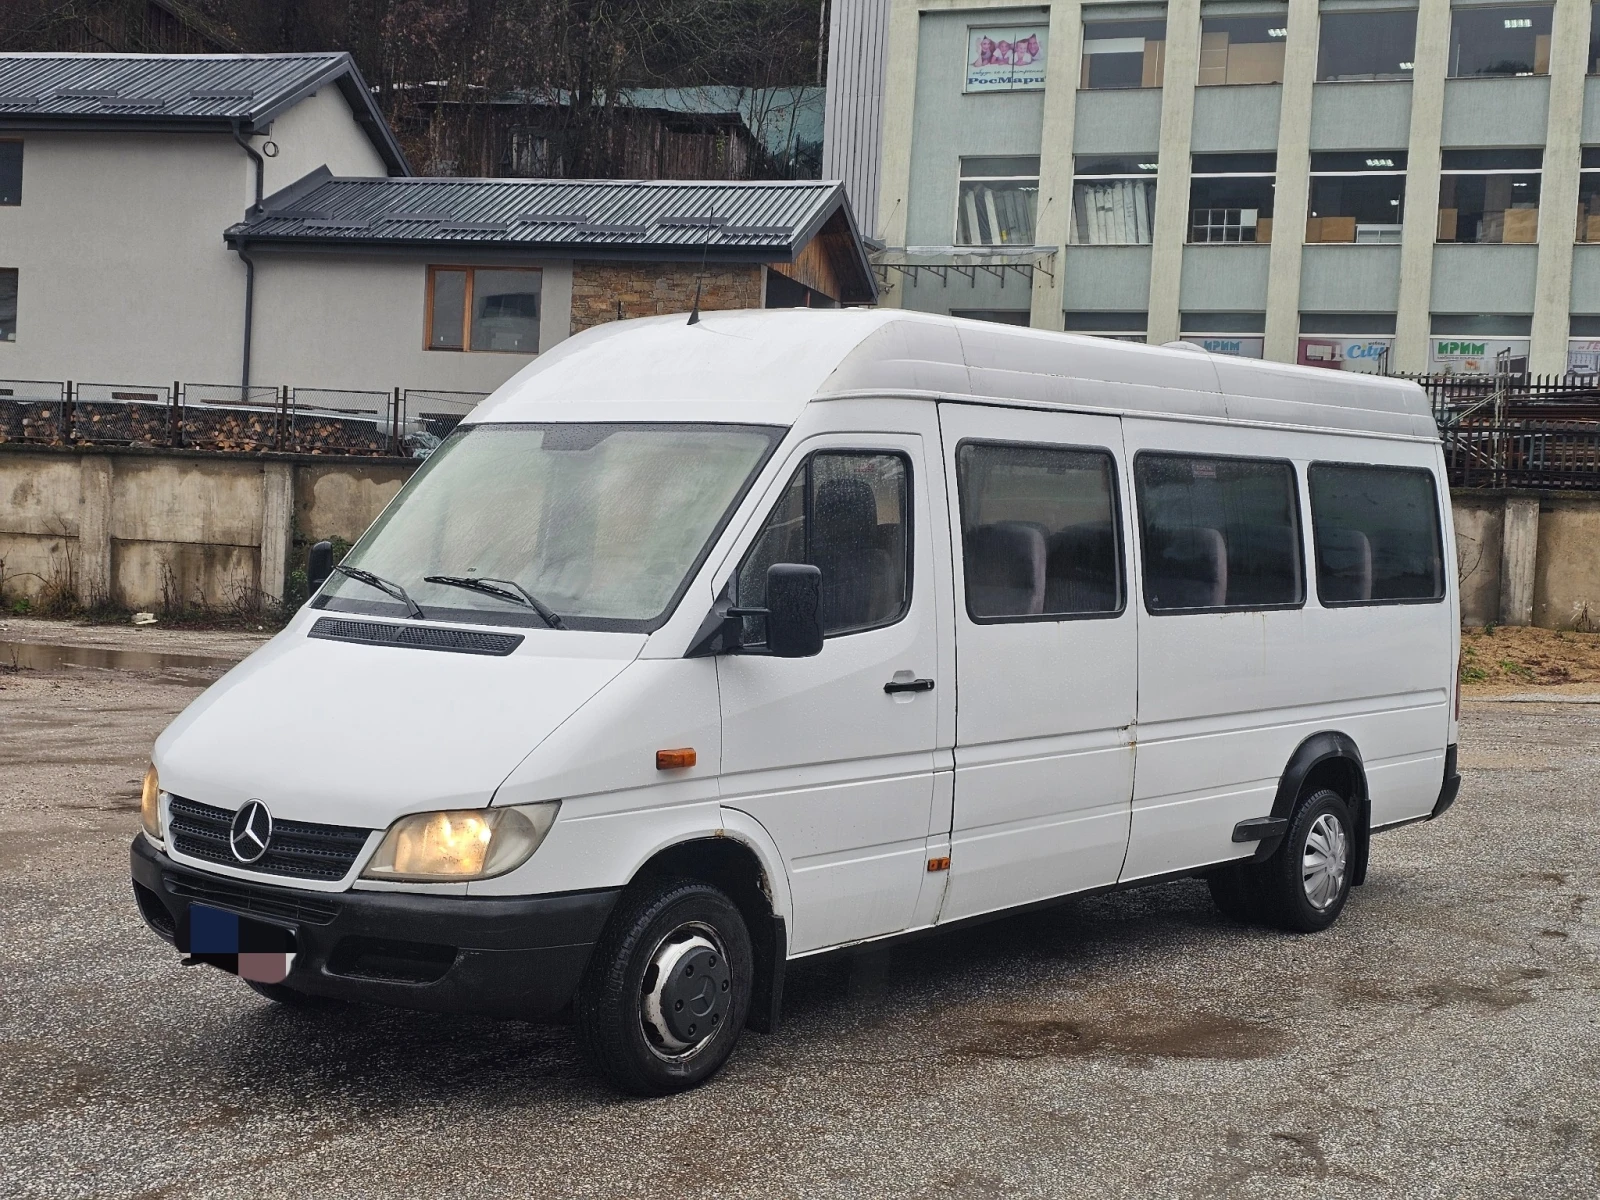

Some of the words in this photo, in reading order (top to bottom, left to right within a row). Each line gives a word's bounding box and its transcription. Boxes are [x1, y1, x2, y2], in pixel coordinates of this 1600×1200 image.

[968, 77, 1046, 85] РосМари
[1204, 340, 1240, 350] ИРИМ
[1437, 342, 1485, 355] ИРИМ
[1347, 343, 1385, 361] City
